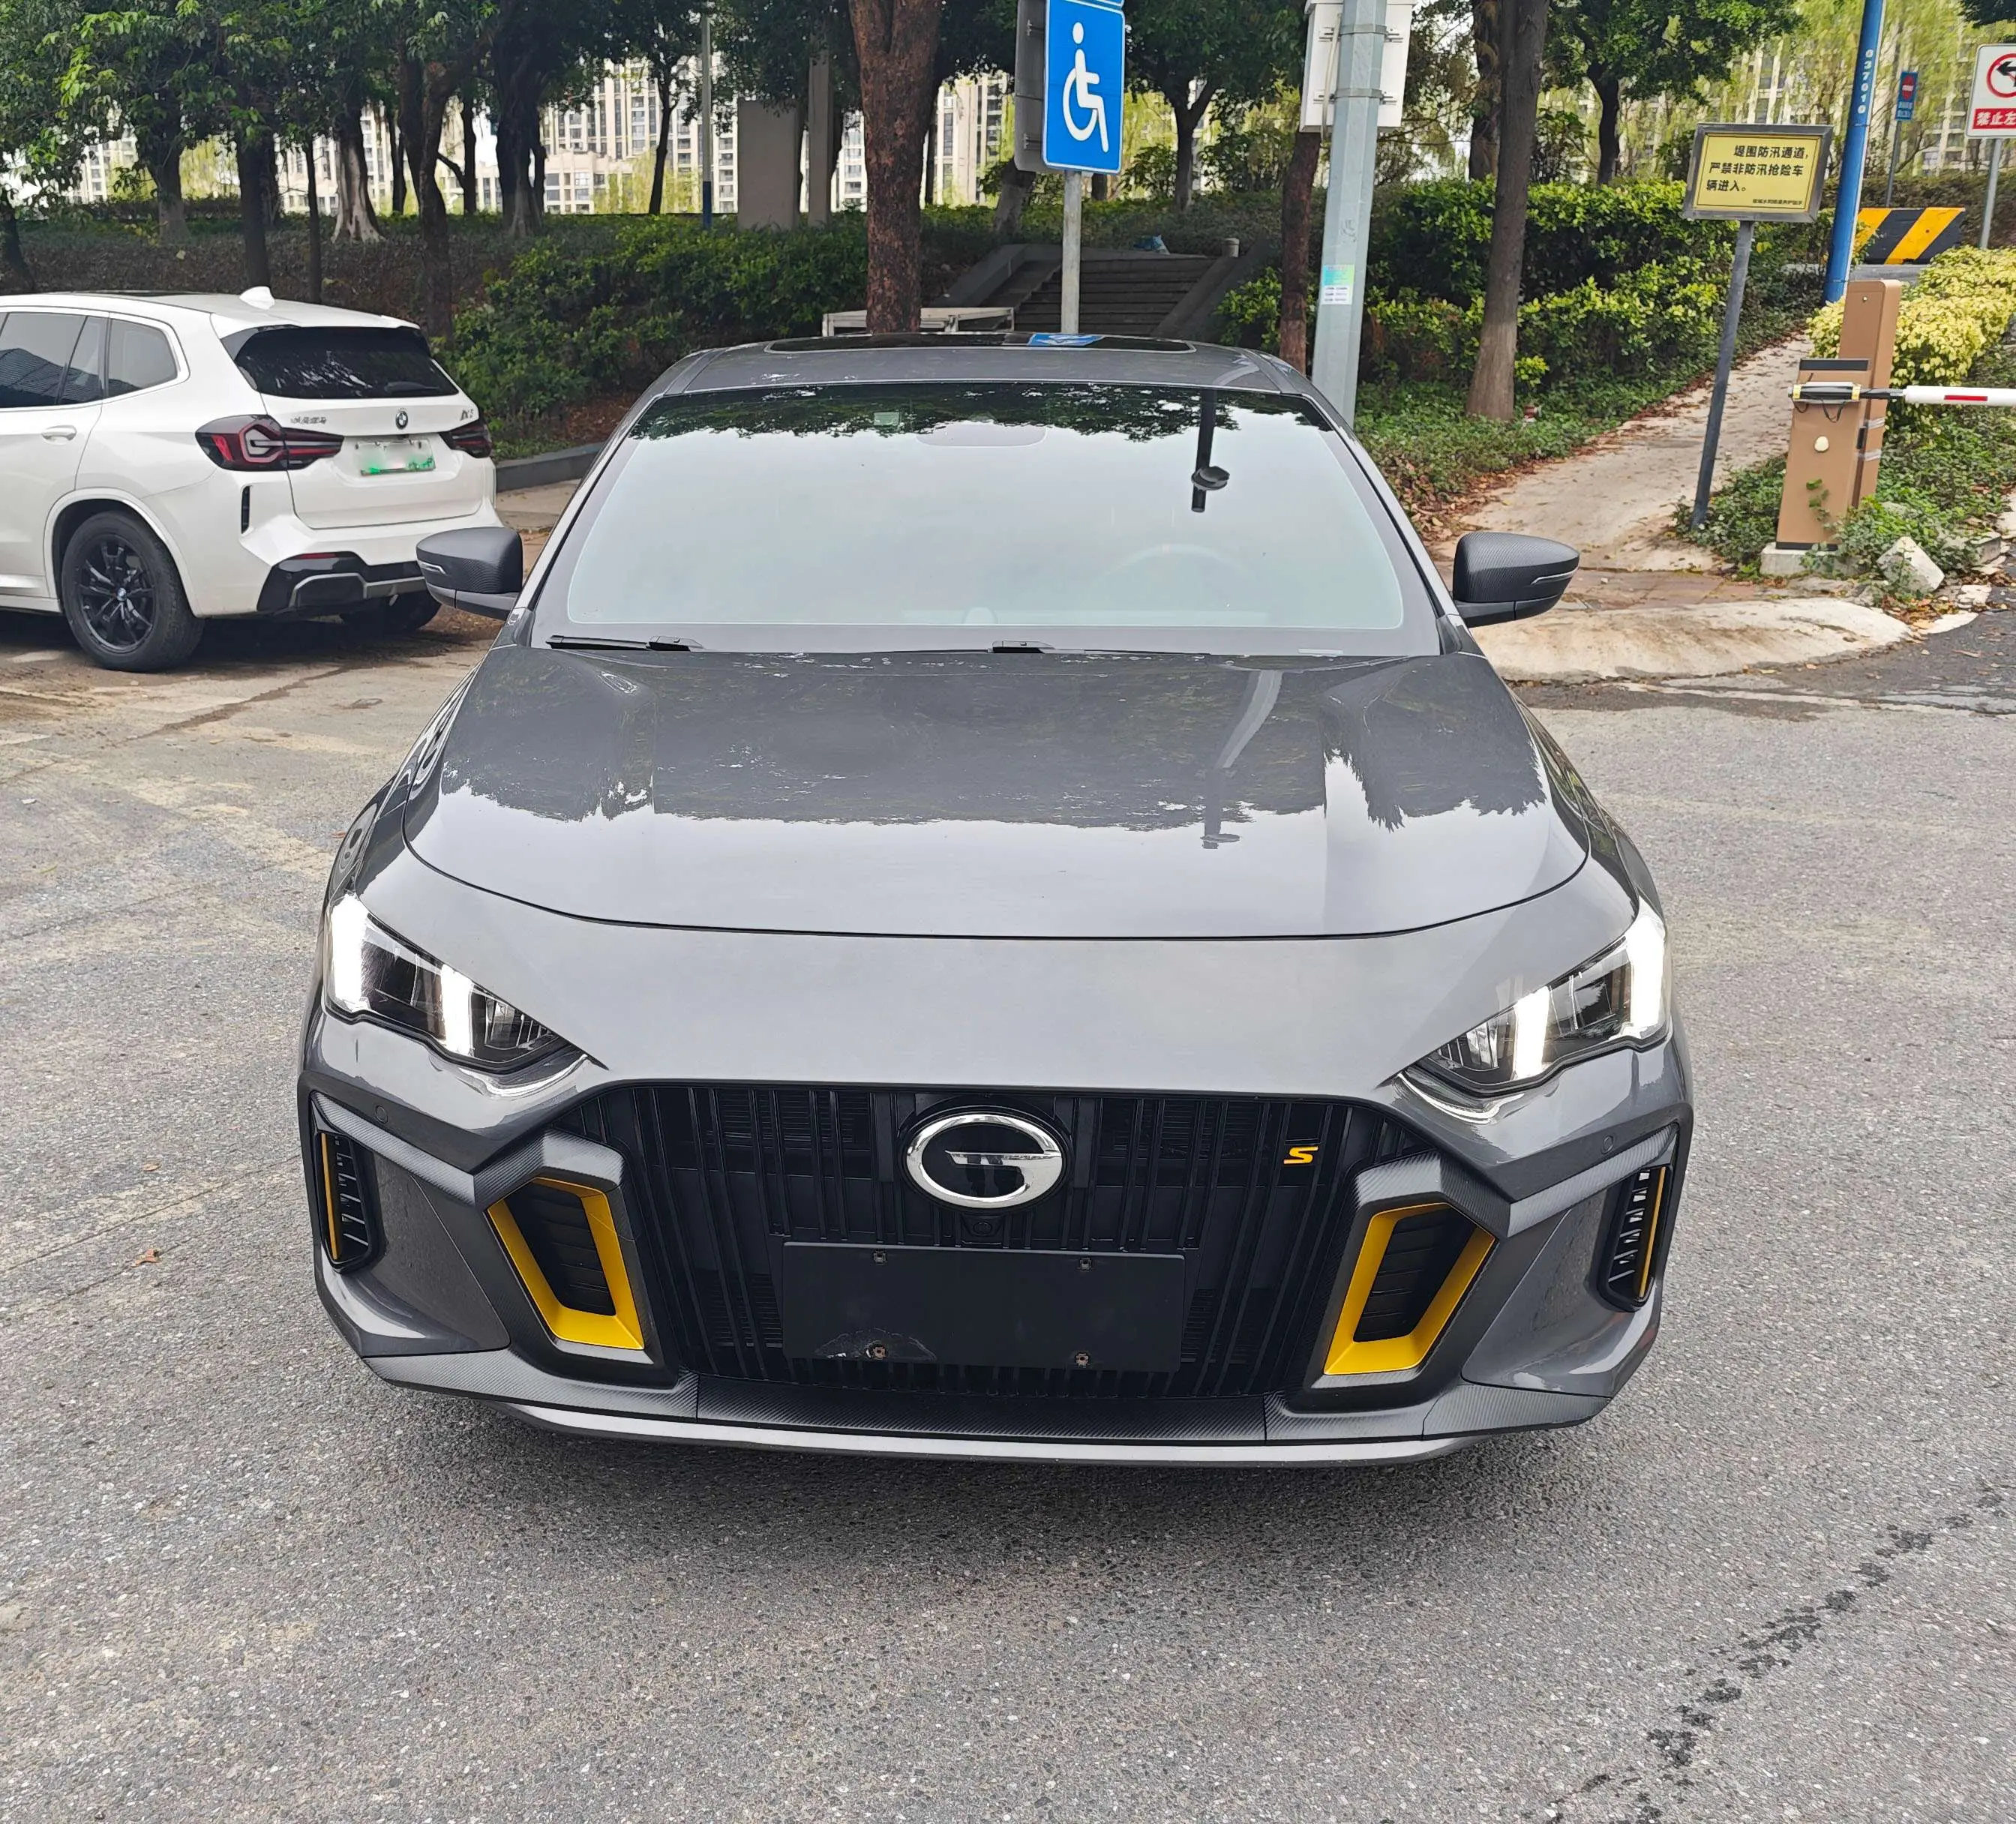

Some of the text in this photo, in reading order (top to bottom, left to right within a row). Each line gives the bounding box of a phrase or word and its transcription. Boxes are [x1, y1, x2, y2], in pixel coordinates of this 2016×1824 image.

[1708, 161, 1804, 177] 严禁非防汛抢险车
[1283, 1146, 1318, 1164] S
